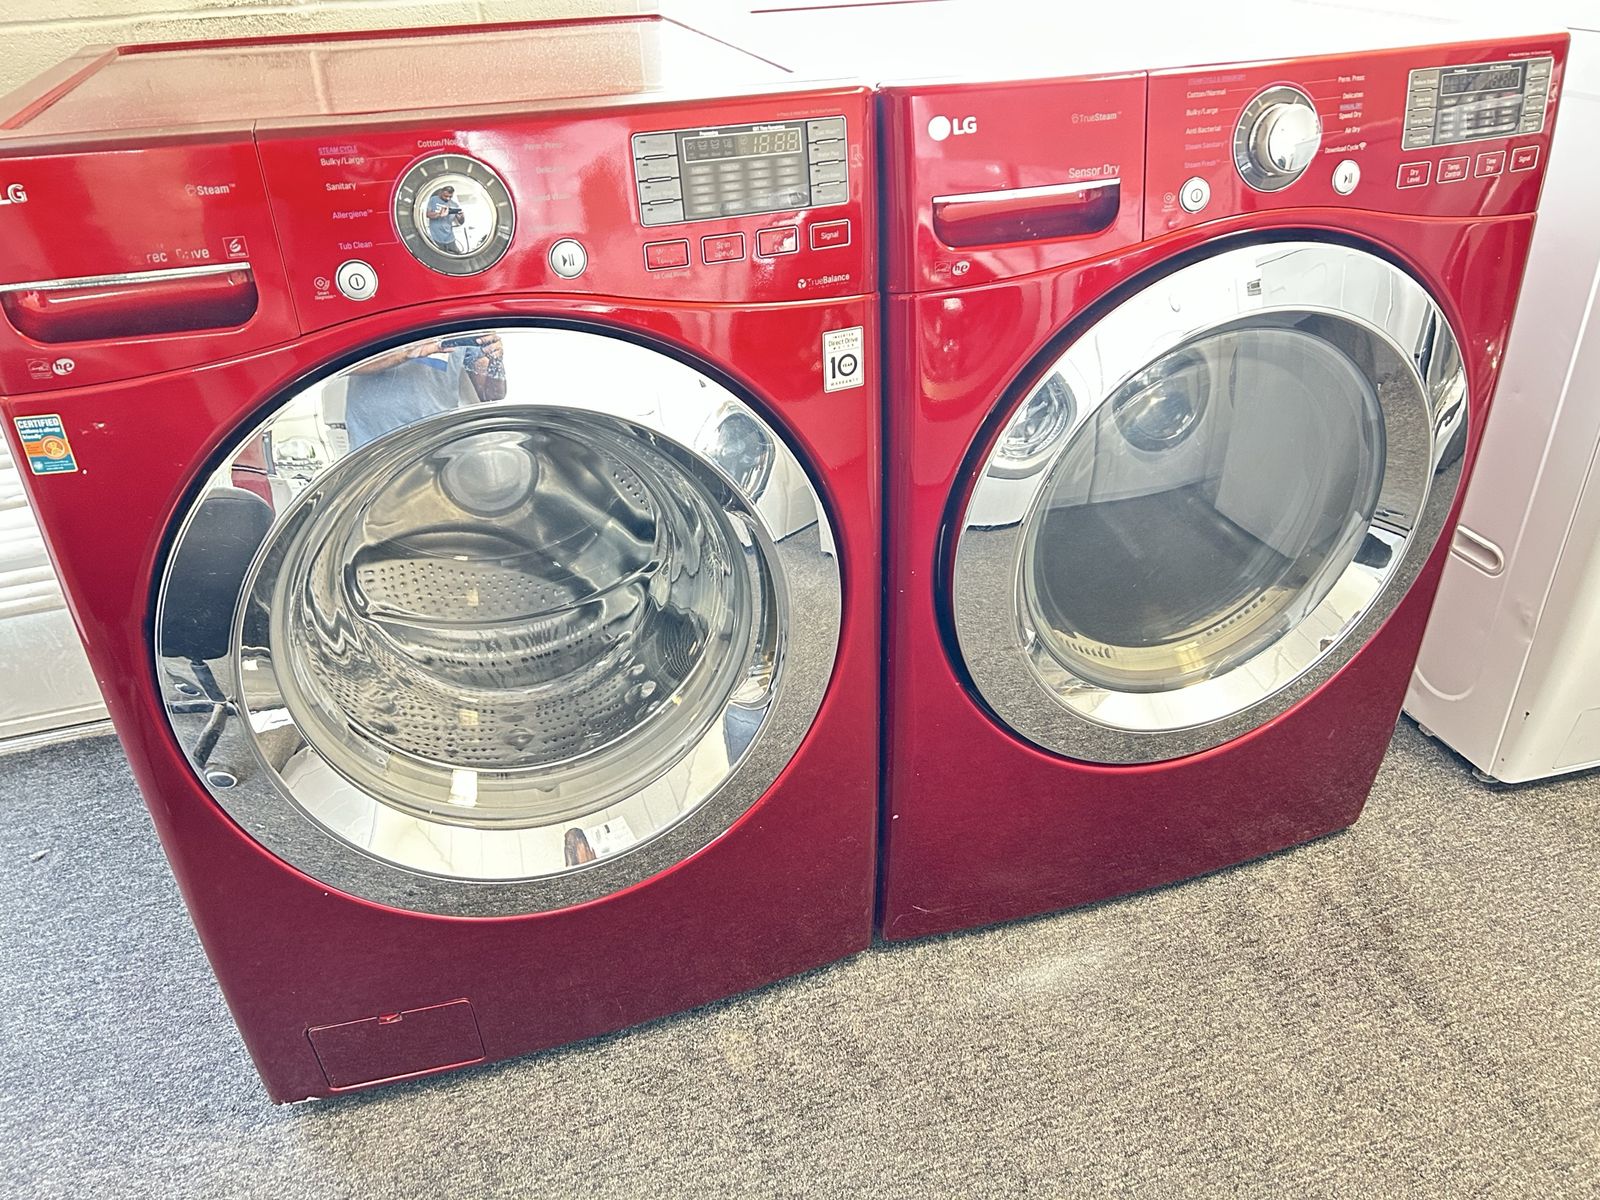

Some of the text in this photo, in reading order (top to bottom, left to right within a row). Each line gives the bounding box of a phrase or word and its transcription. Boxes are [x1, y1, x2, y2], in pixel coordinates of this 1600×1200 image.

[953, 116, 977, 135] LG
[320, 156, 365, 166] Bulky/Large
[1068, 163, 1120, 179] Sensor Dry
[326, 182, 356, 191] Sanitary
[820, 230, 839, 240] Signal
[353, 241, 372, 249] Clean
[17, 418, 60, 429] CERTIFIED
